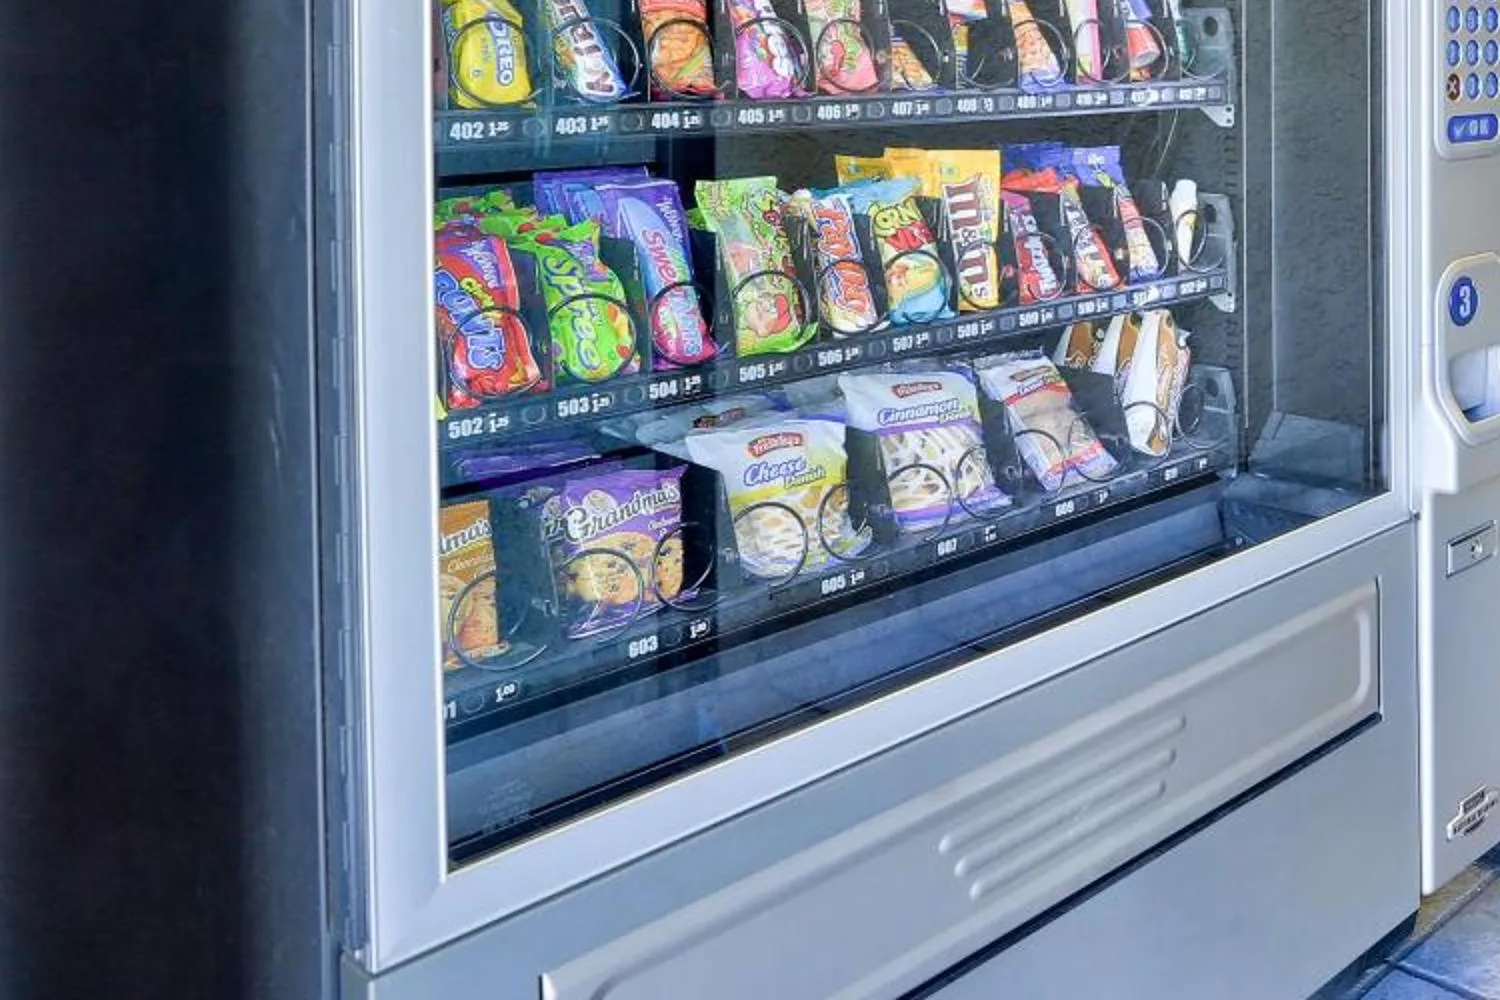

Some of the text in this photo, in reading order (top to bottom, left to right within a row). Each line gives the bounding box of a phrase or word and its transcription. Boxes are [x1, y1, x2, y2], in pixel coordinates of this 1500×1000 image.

[738, 108, 764, 124] 405
[817, 104, 841, 120] 406
[892, 101, 913, 116] 407
[555, 116, 587, 135] 403
[651, 112, 680, 129] 404
[450, 122, 484, 140] 402
[1459, 285, 1471, 319] 3
[739, 363, 766, 382] 505
[649, 379, 678, 399] 504
[557, 397, 590, 417] 503
[877, 399, 961, 426] Cinnamon
[448, 417, 483, 439] 502
[743, 456, 808, 487] Cheese
[563, 478, 681, 545] Grandma's
[628, 634, 659, 658] 603
